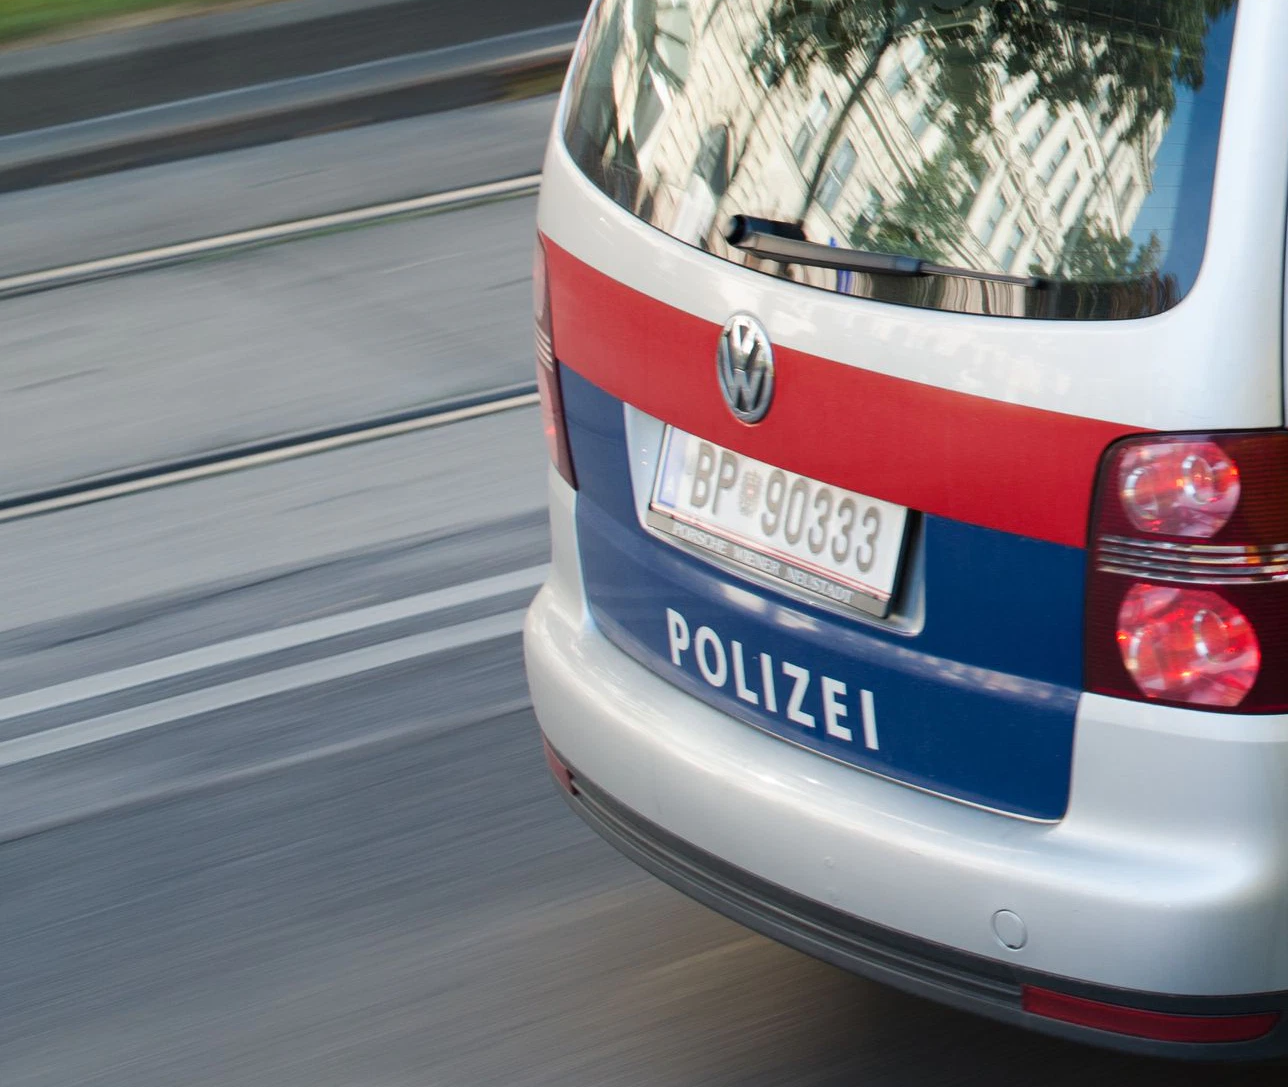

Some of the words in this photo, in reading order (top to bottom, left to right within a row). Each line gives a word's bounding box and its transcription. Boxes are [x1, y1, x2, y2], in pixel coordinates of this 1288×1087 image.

[672, 521, 728, 555] PORSCHE
[690, 441, 738, 516] BP
[761, 468, 882, 574] 90333
[666, 607, 880, 751] POLIZEI
